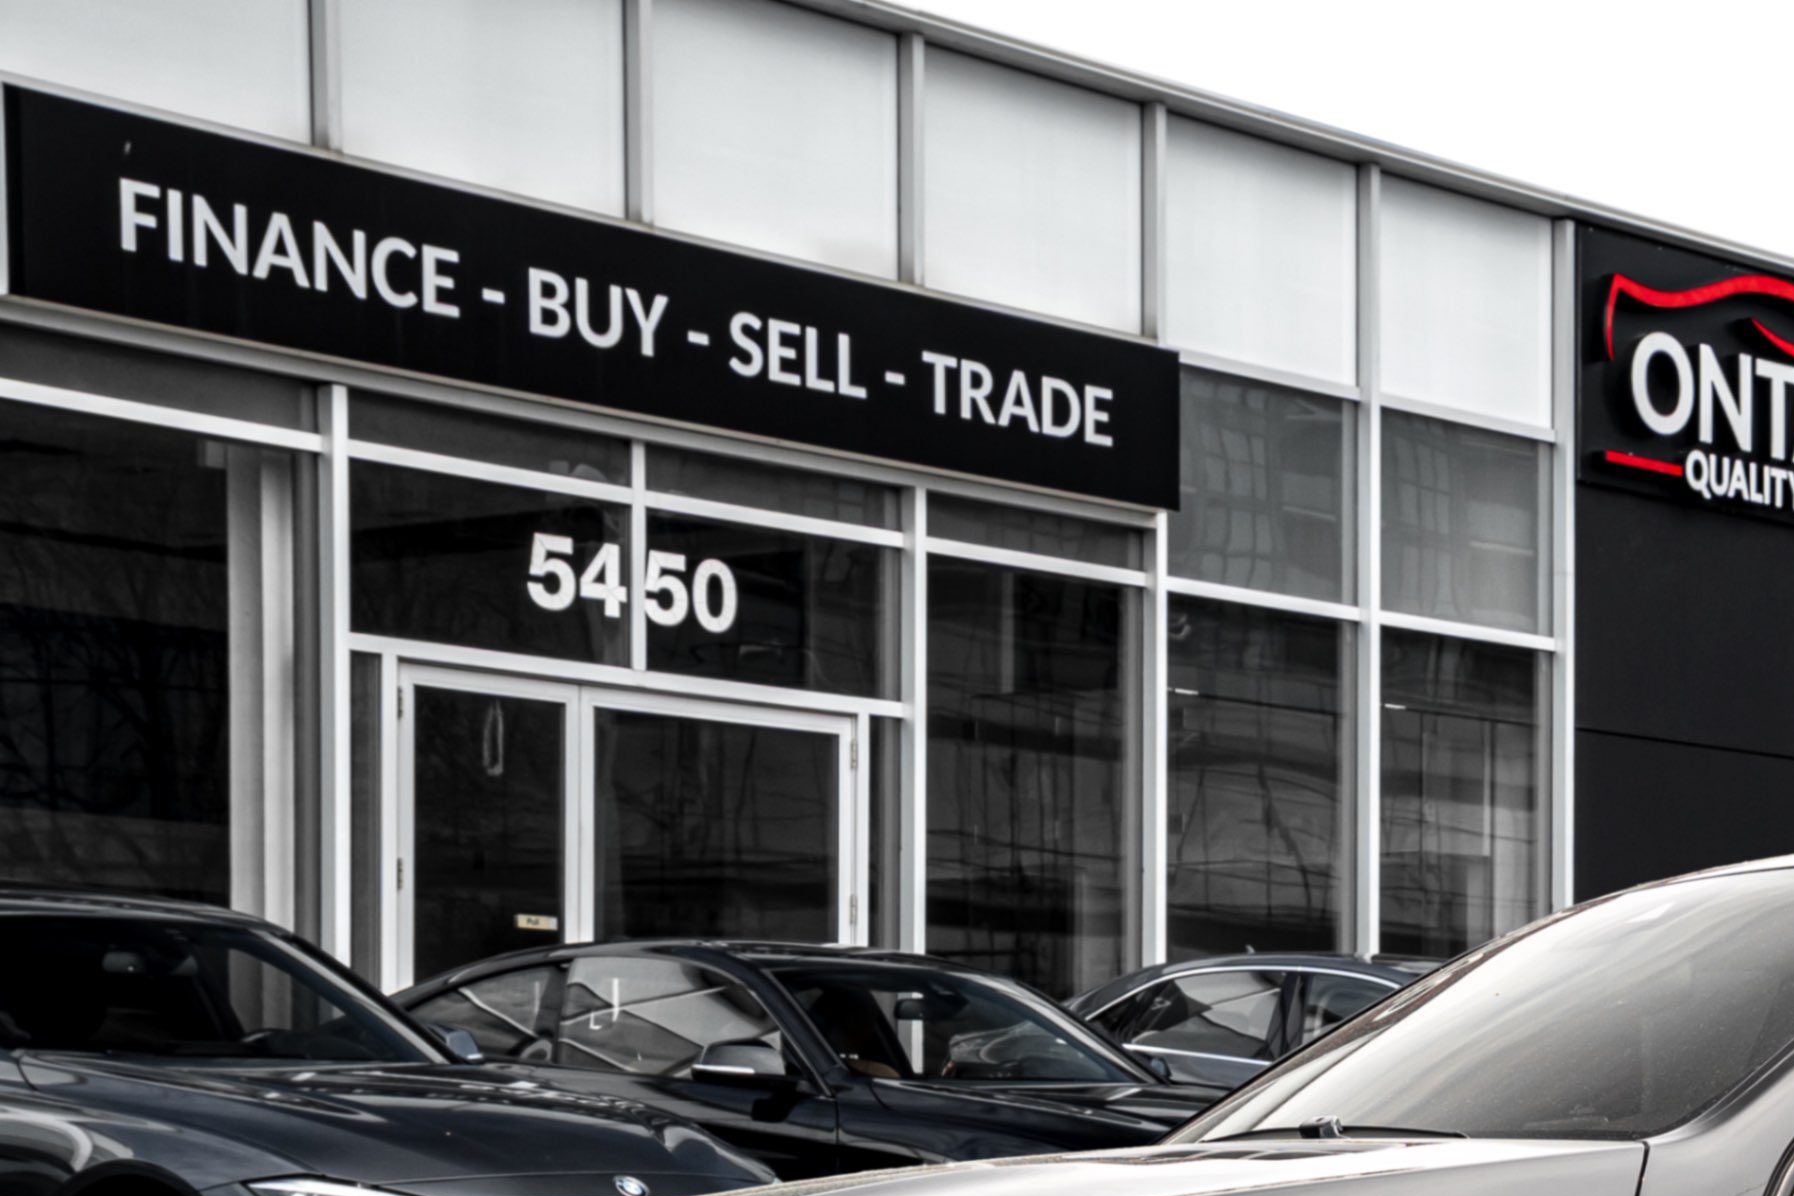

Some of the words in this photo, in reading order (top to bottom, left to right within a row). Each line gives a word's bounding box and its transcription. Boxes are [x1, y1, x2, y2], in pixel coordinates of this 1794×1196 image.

[119, 177, 460, 318] FINANCE
[528, 267, 669, 357] BUY
[729, 311, 867, 399] SELL
[922, 350, 1114, 447] TRADE
[527, 532, 738, 634] 5450
